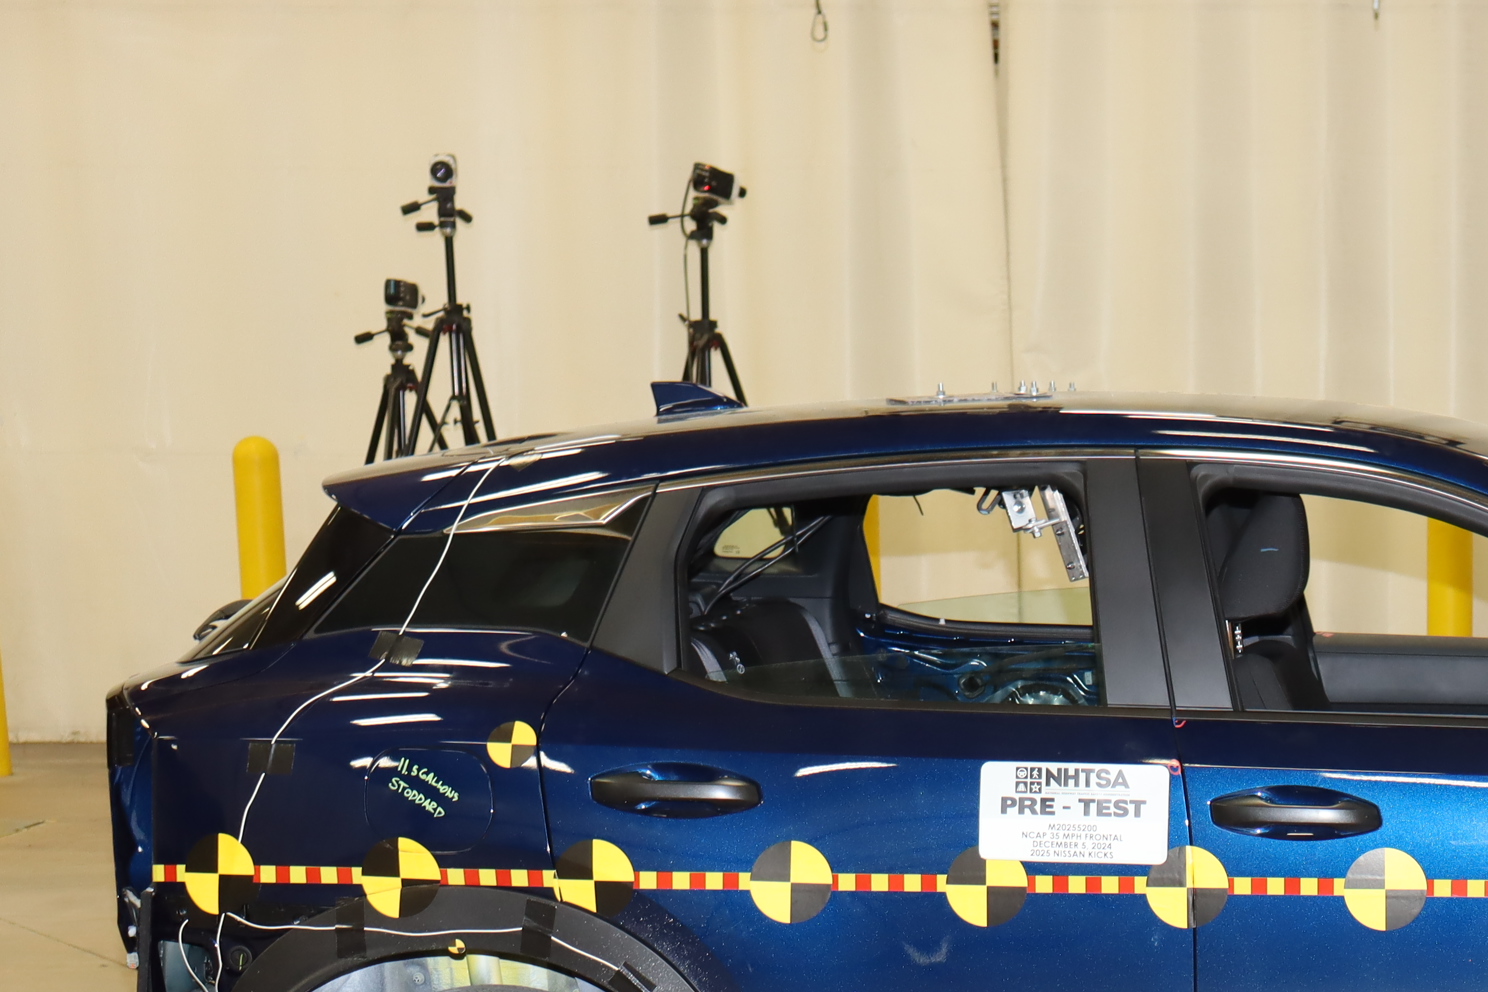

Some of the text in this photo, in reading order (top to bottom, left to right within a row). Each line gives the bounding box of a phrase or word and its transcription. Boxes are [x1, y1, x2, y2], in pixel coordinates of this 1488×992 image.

[419, 768, 459, 802] GALLONS
[1045, 767, 1130, 789] NHTSA
[388, 777, 445, 818] STODDARD
[1000, 796, 1056, 816] PRE
[1078, 797, 1147, 818] TEST
[1048, 823, 1097, 832] M20255200
[1021, 831, 1124, 842] NCAP 35 MPH FRONTAL
[1032, 840, 1079, 850] DECEMBER
[1091, 842, 1112, 850] 2024
[1030, 849, 1114, 859] 2025 NISSAN KICKS
